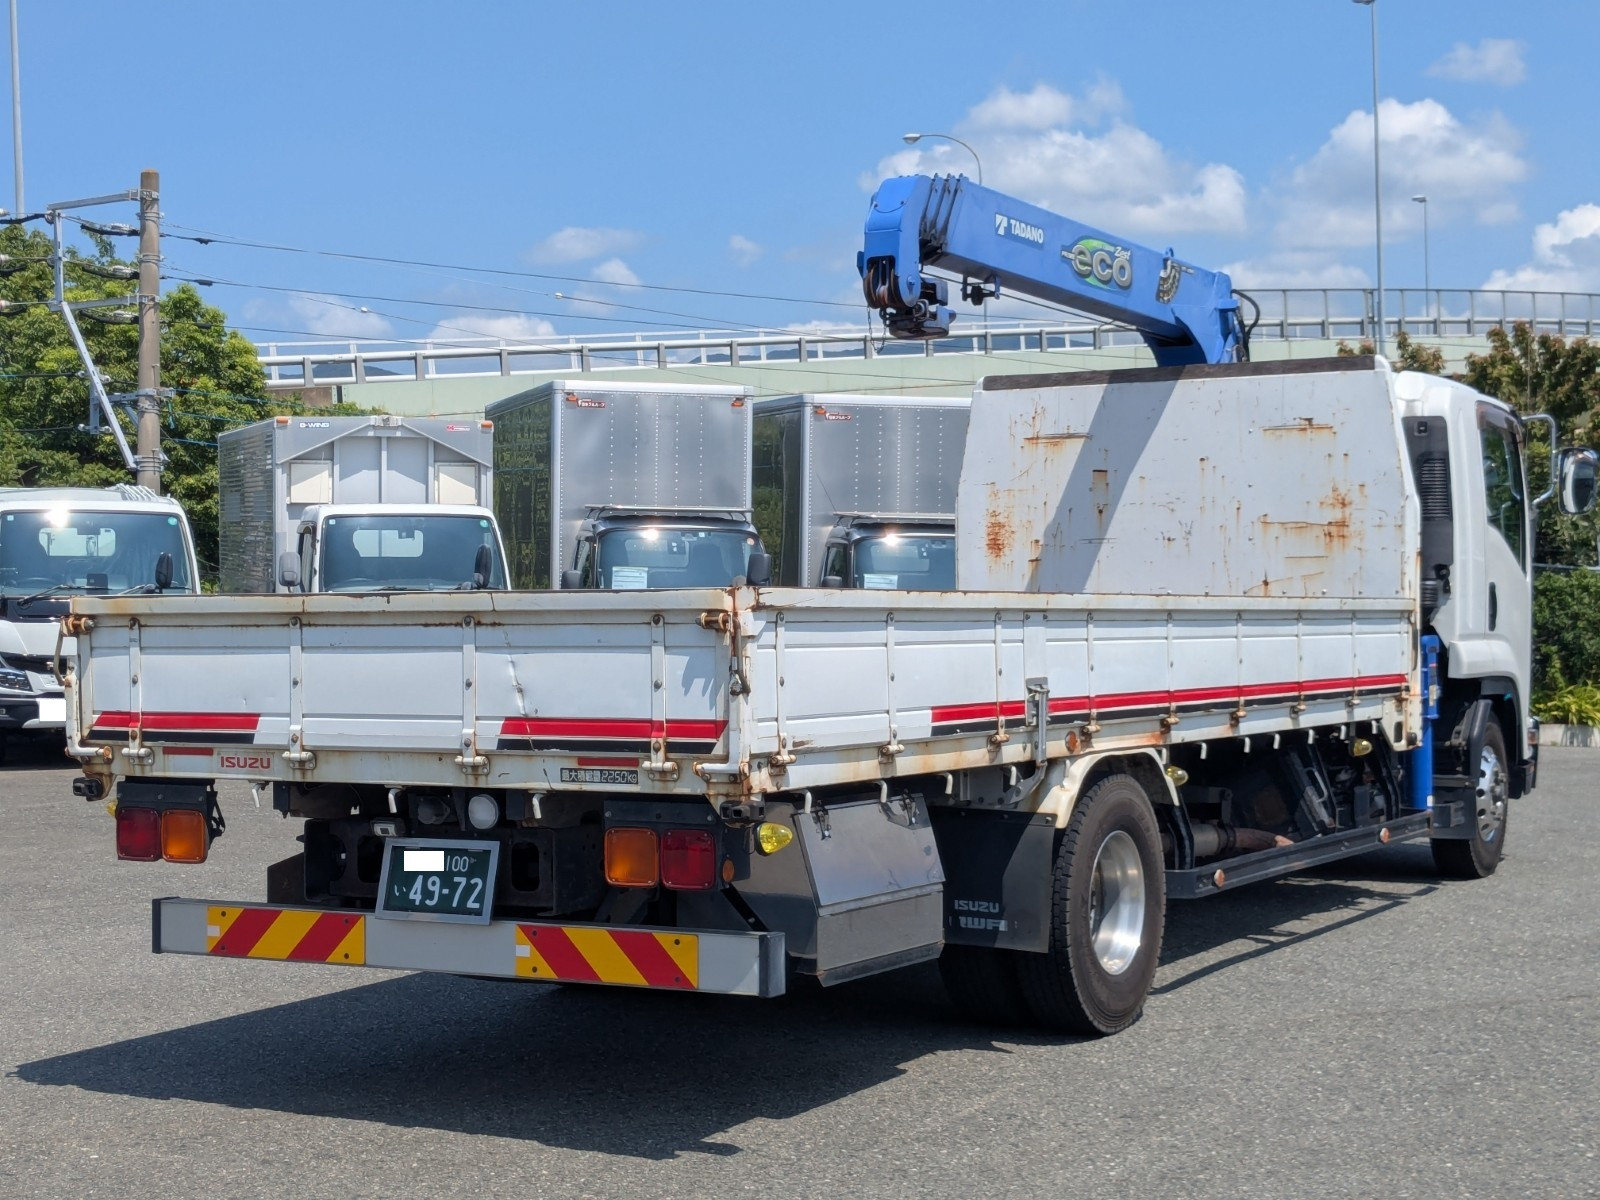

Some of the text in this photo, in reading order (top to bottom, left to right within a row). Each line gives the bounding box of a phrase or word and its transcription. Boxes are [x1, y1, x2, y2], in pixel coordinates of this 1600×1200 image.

[1010, 218, 1044, 244] TADANO
[1071, 244, 1132, 287] eco
[220, 756, 271, 769] ISUZU
[445, 855, 469, 872] 100
[408, 874, 483, 909] 49-72
[954, 899, 1000, 913] ISUZU
